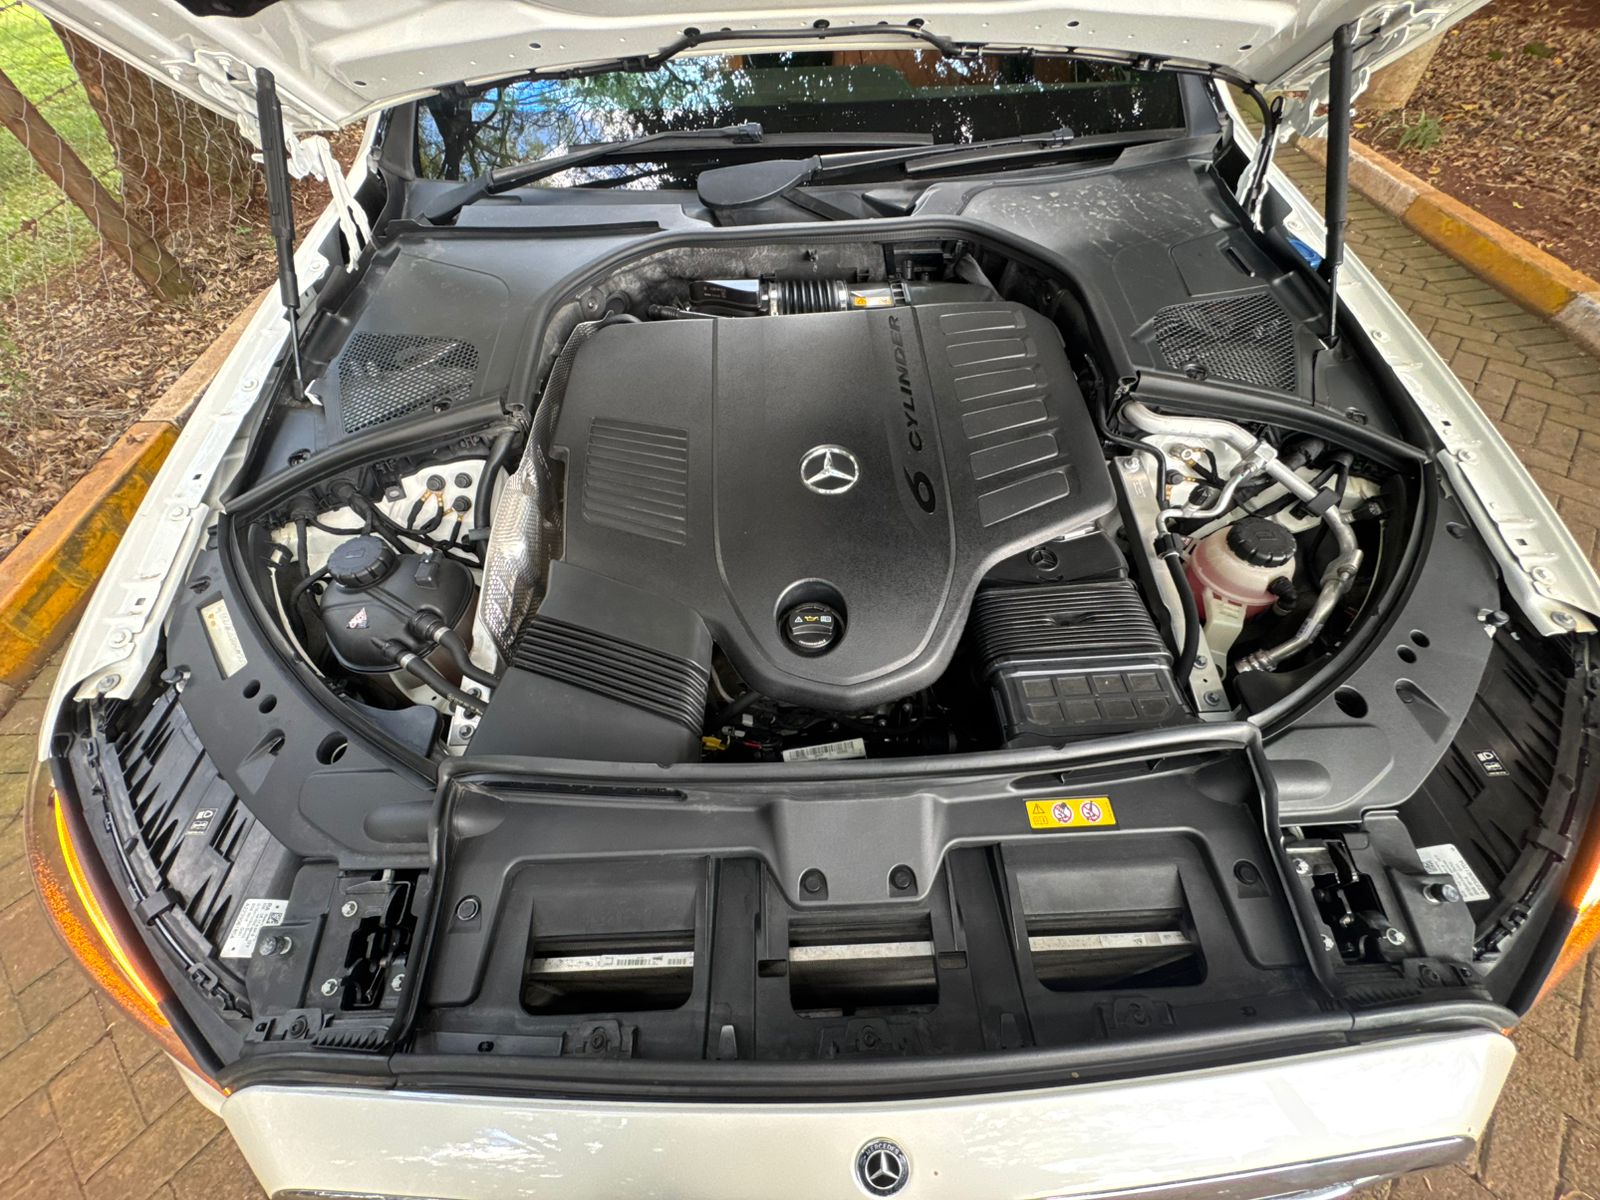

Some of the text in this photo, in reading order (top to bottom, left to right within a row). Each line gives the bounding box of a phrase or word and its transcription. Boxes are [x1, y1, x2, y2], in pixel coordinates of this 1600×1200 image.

[888, 315, 936, 514] 6 CYLINDER
[865, 1143, 900, 1156] MERCEDES
